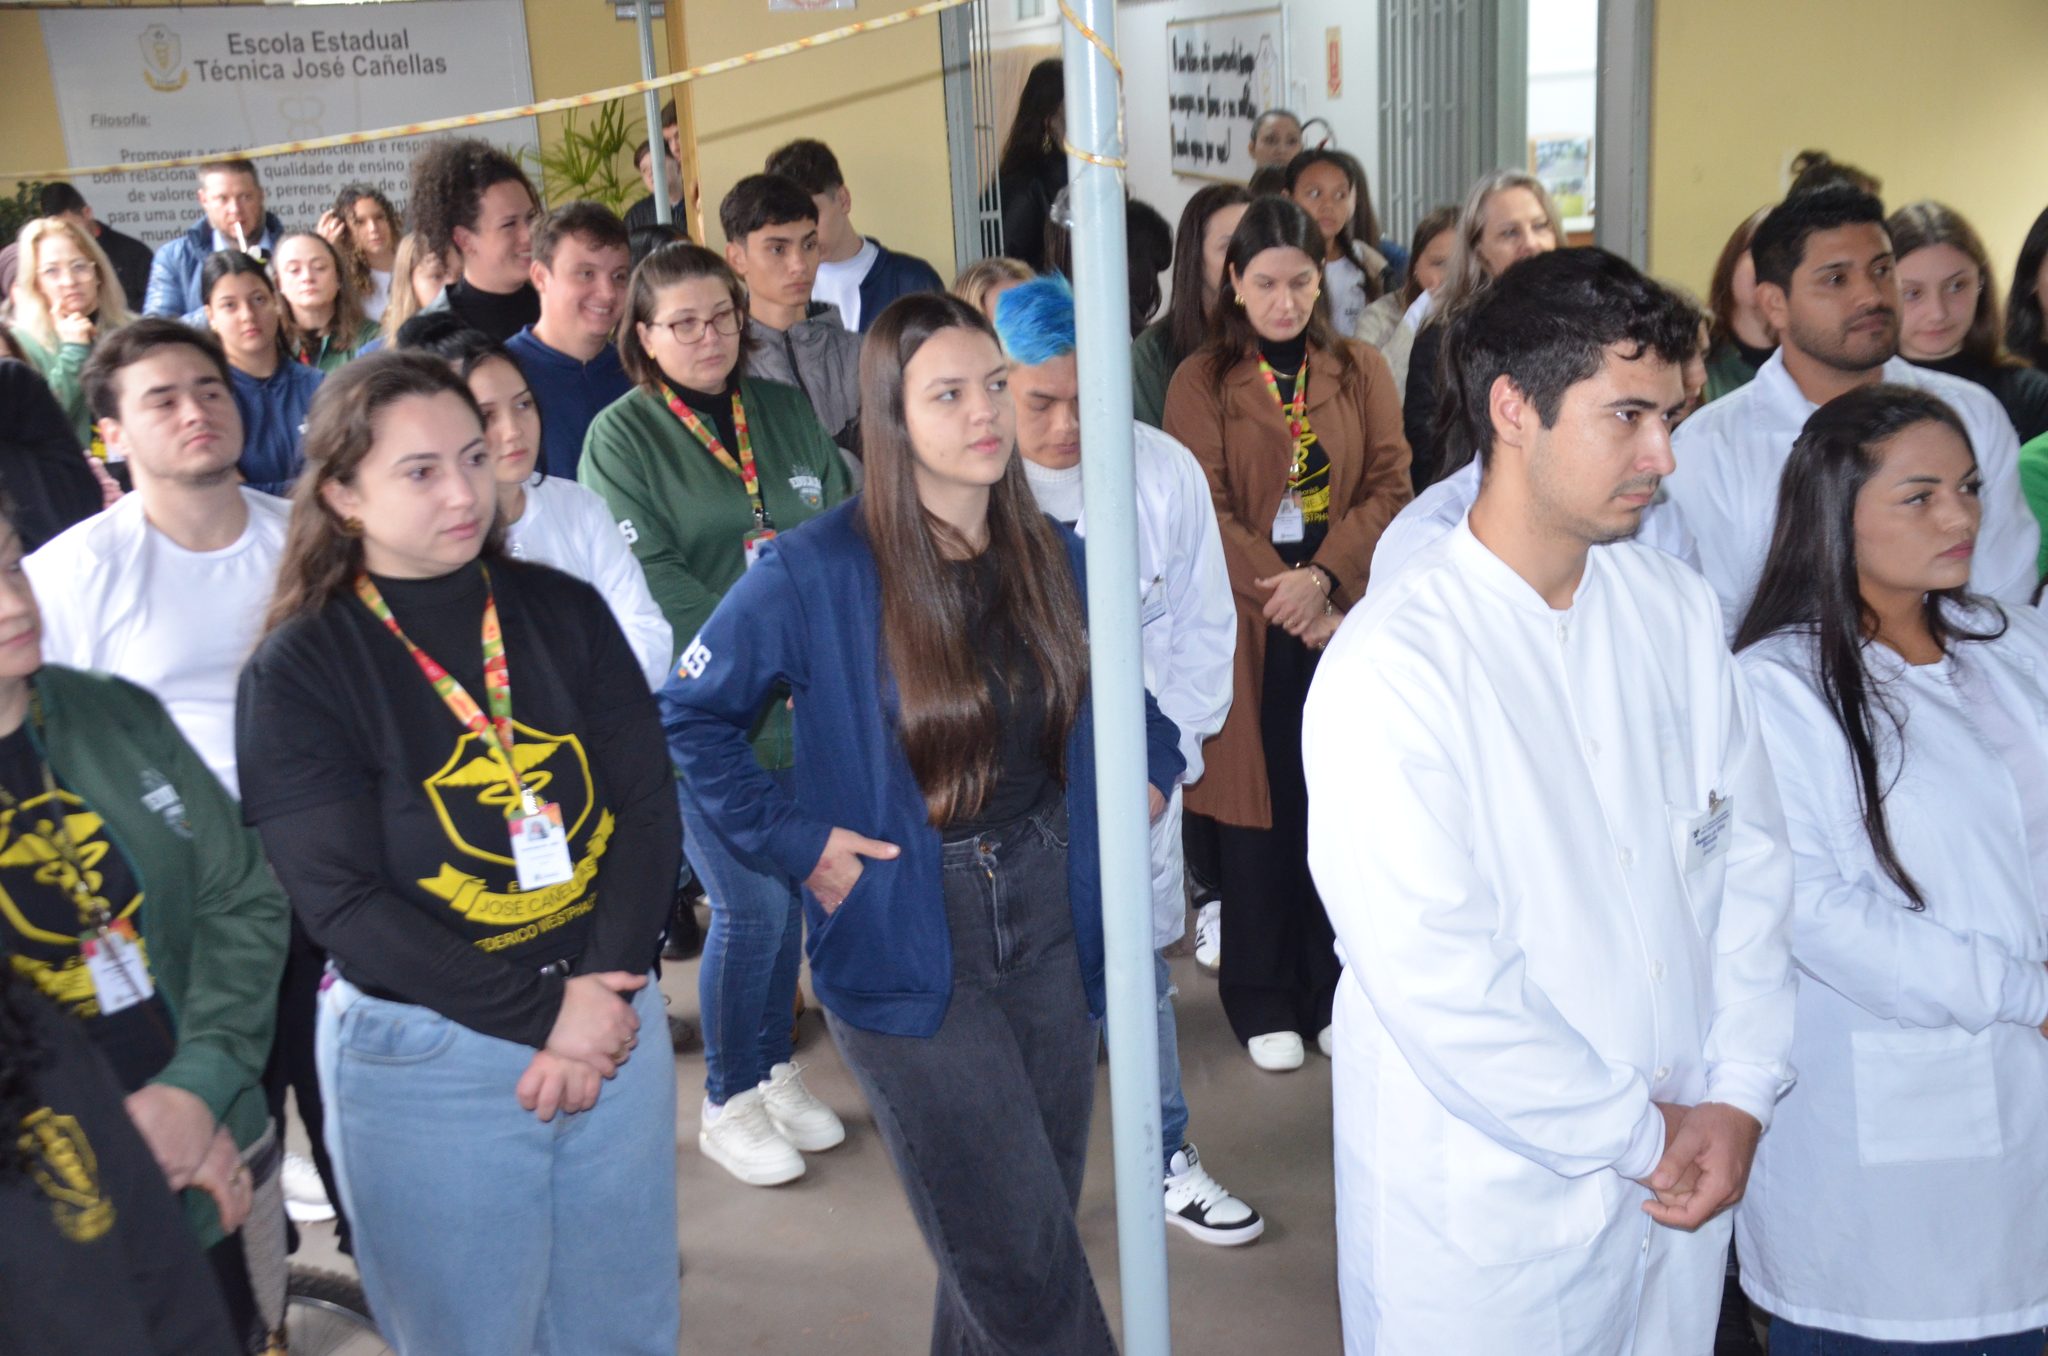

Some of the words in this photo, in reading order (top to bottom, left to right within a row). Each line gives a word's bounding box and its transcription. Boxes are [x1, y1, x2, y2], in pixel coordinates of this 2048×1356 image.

[227, 31, 305, 55] Escola
[311, 28, 410, 52] Estadual
[194, 57, 285, 82] Técnica
[292, 55, 345, 79] José
[352, 52, 448, 76] Cañellas
[90, 112, 151, 129] Filosofia:
[120, 148, 193, 163] Promover
[130, 167, 197, 183] relaciona
[264, 161, 334, 180] qualidade
[338, 159, 355, 175] de
[359, 158, 405, 173] ensino
[128, 187, 146, 203] de
[150, 186, 198, 202] valore
[276, 183, 336, 199] perenes,
[267, 202, 295, 216] usca
[298, 200, 315, 215] de
[107, 211, 141, 227] para
[145, 209, 177, 222] uma
[141, 226, 187, 241] mund
[618, 518, 639, 545] S
[479, 896, 525, 917] JOSÉ
